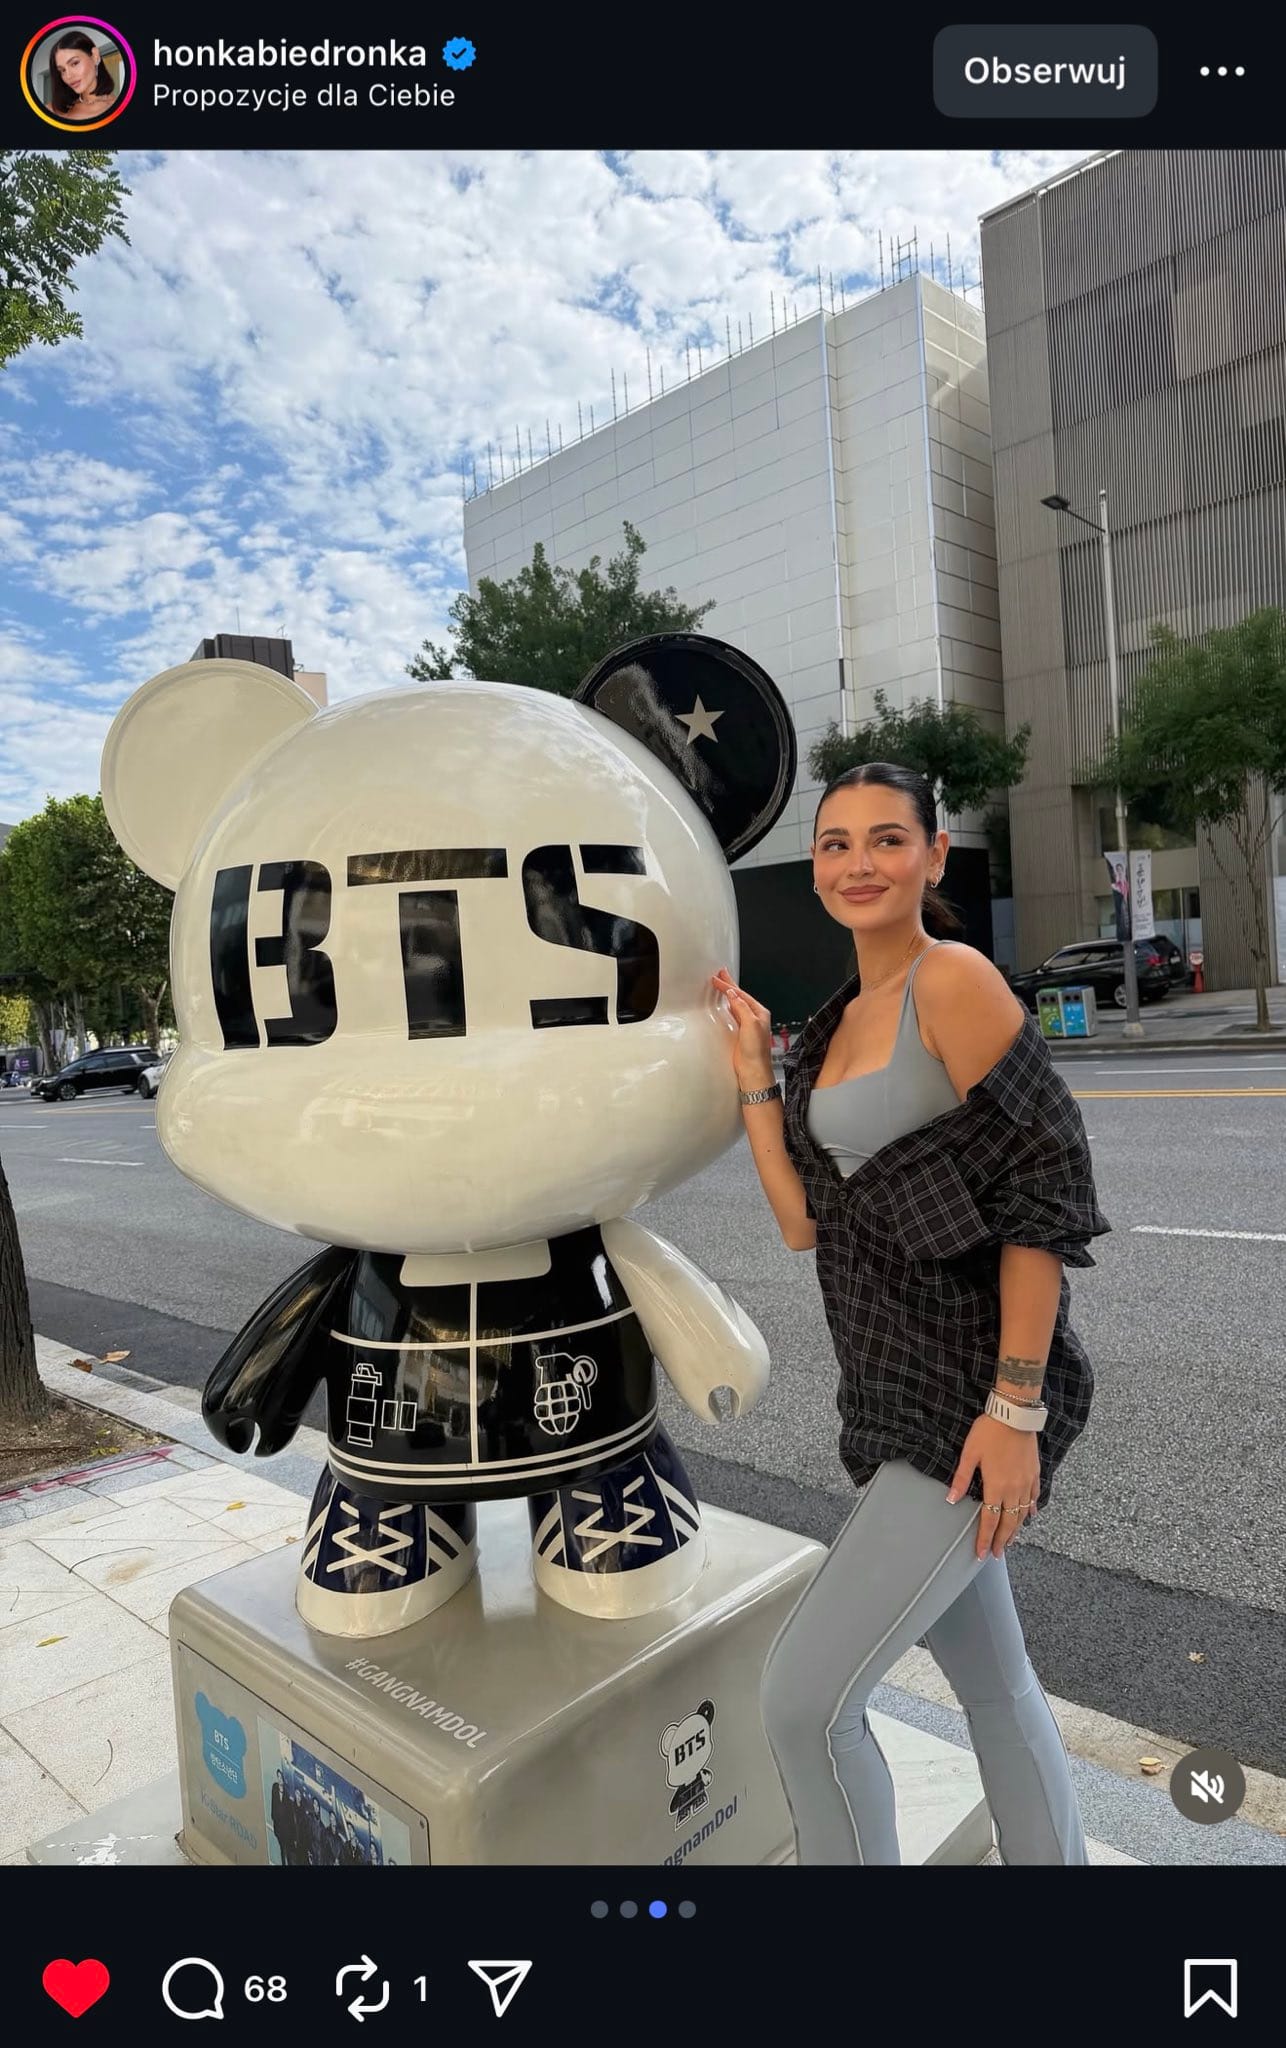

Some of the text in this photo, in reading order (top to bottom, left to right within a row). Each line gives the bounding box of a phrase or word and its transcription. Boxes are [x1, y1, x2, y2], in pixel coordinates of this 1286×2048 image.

[210, 844, 660, 1050] BTS
[345, 1657, 488, 1749] #GANGNAMDOL
[213, 1728, 230, 1751] BTS
[674, 1729, 706, 1767] BTS
[662, 1796, 738, 1865] ngnamDol
